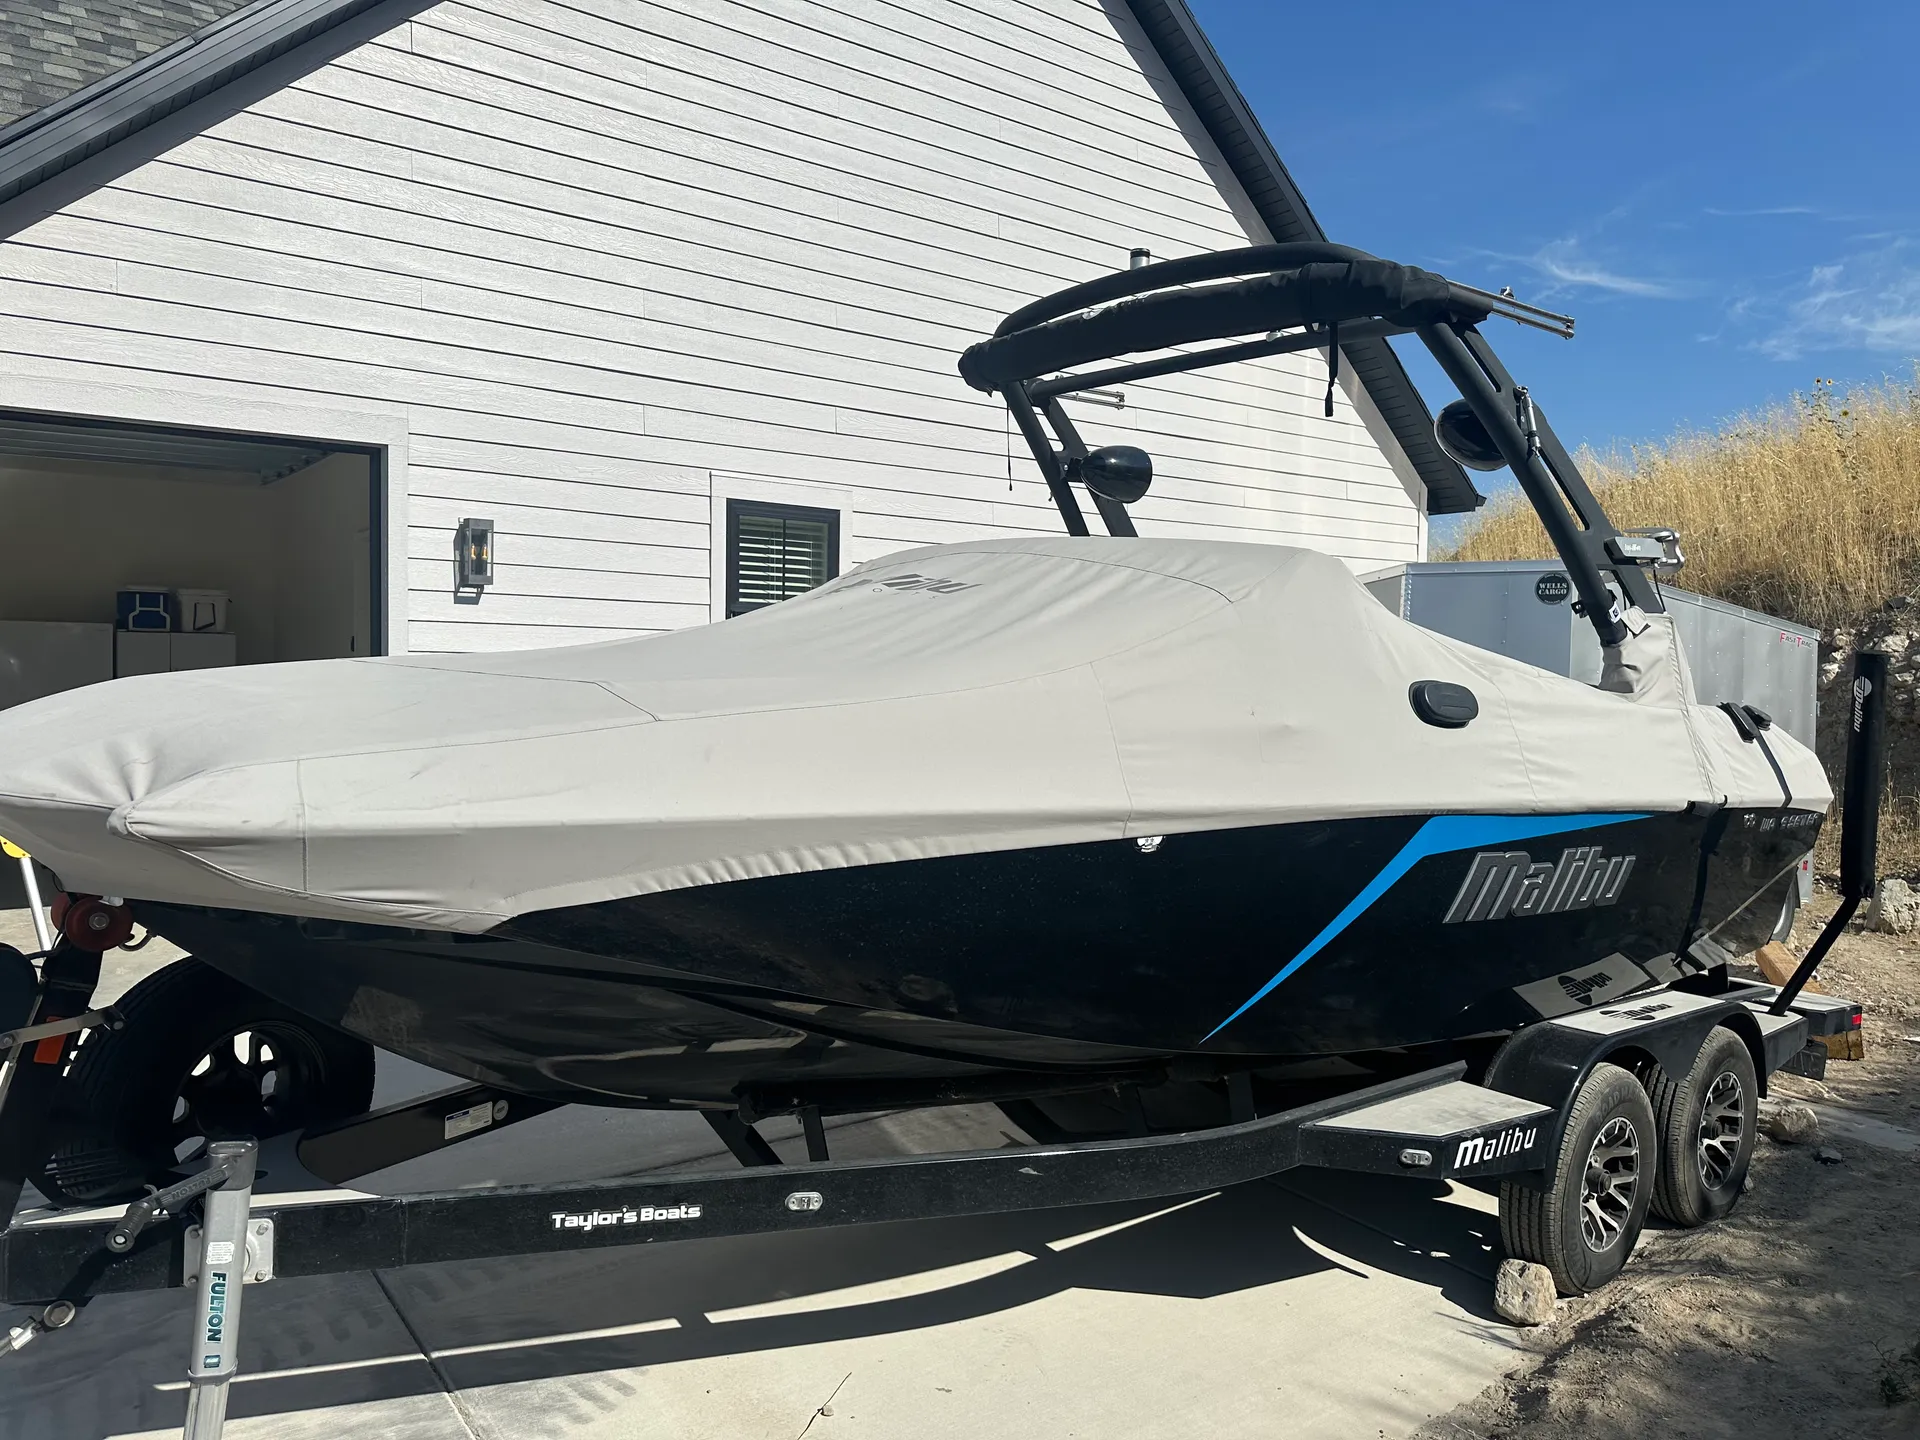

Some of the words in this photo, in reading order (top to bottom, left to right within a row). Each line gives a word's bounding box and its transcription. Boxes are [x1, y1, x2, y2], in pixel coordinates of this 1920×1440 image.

[1853, 686, 1864, 733] Malibu
[1442, 846, 1637, 924] Malibu
[1453, 1126, 1537, 1169] Malibu
[551, 1207, 638, 1231] Taylor's
[640, 1205, 701, 1222] Boats
[206, 1271, 228, 1343] FULTON
